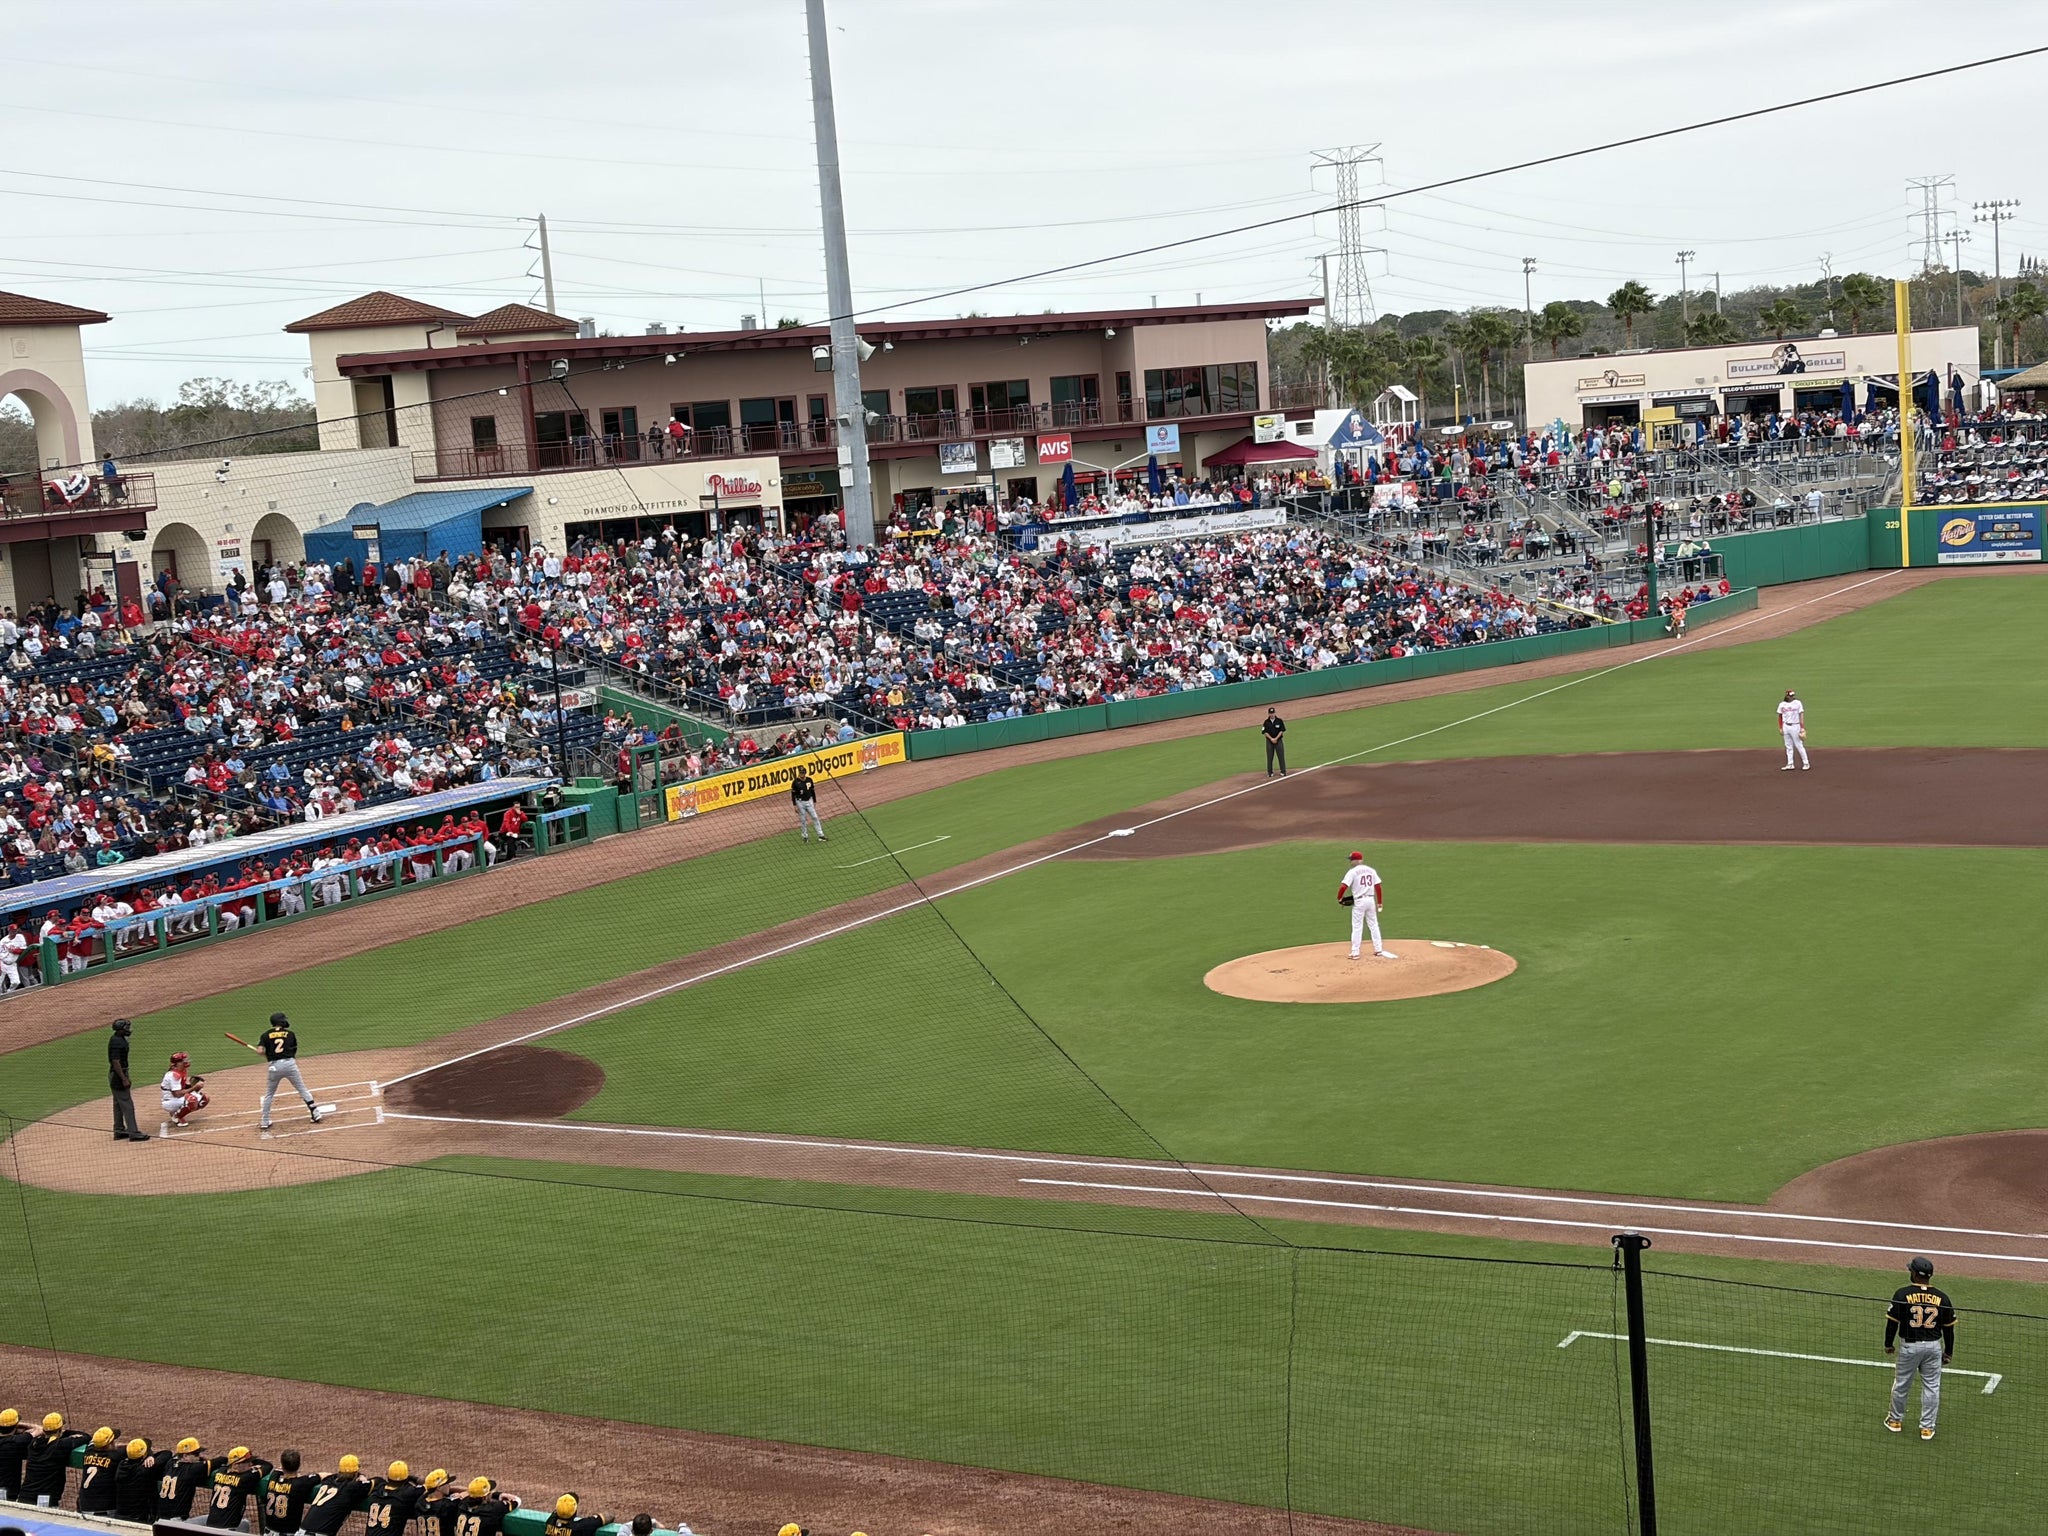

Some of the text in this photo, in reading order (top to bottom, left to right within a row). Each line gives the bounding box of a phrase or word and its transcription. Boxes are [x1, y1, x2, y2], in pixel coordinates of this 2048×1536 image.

[1730, 358, 1843, 373] BULLPEN GRILLE
[1040, 441, 1068, 456] AVIS
[709, 474, 762, 495] Phillies
[583, 500, 688, 515] DIAMOND OUTFITTERS
[1885, 520, 1900, 529] 329
[1940, 520, 1976, 543] Hatfield
[722, 780, 744, 797] VIP
[808, 752, 853, 776] DUGOUT
[1360, 875, 1372, 887] 43
[274, 1038, 284, 1053] 2
[1906, 1293, 1942, 1306] MATTISON
[1909, 1305, 1938, 1329] 32
[83, 1466, 97, 1489] 7
[266, 1492, 288, 1519] 28
[367, 1502, 392, 1528] 94
